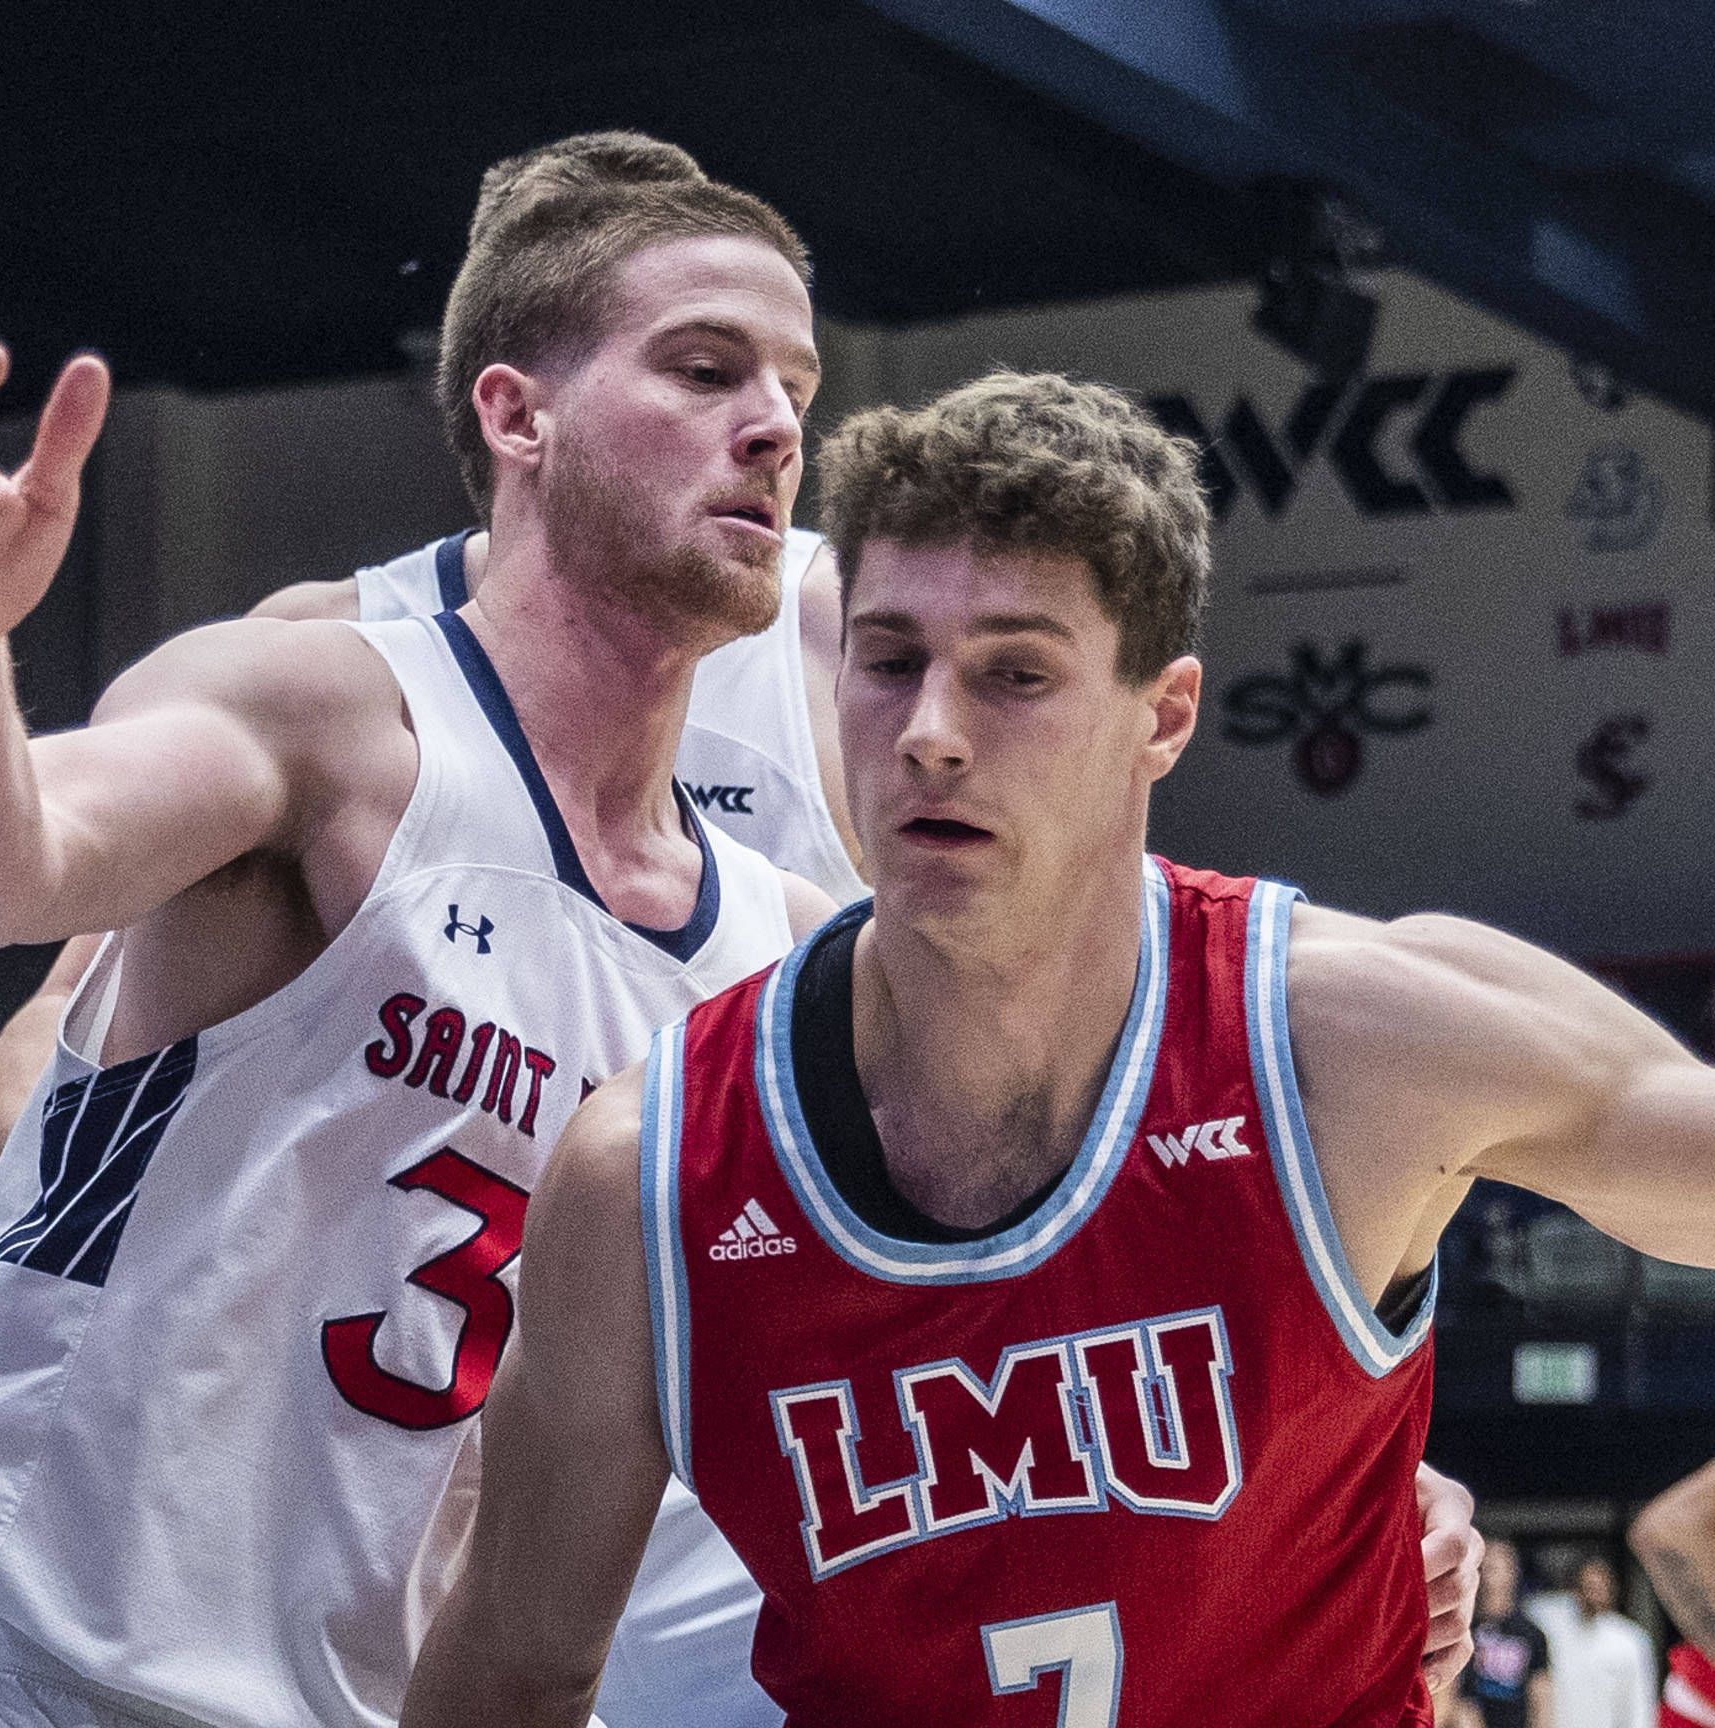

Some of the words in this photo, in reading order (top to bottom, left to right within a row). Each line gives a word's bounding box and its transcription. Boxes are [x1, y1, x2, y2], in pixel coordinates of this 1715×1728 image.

[687, 783, 754, 814] WCC
[365, 992, 556, 1137] SAINT
[1147, 1116, 1250, 1169] WCC
[320, 1147, 531, 1431] 3
[709, 1230, 797, 1260] adidas
[770, 1305, 1242, 1582] LMU
